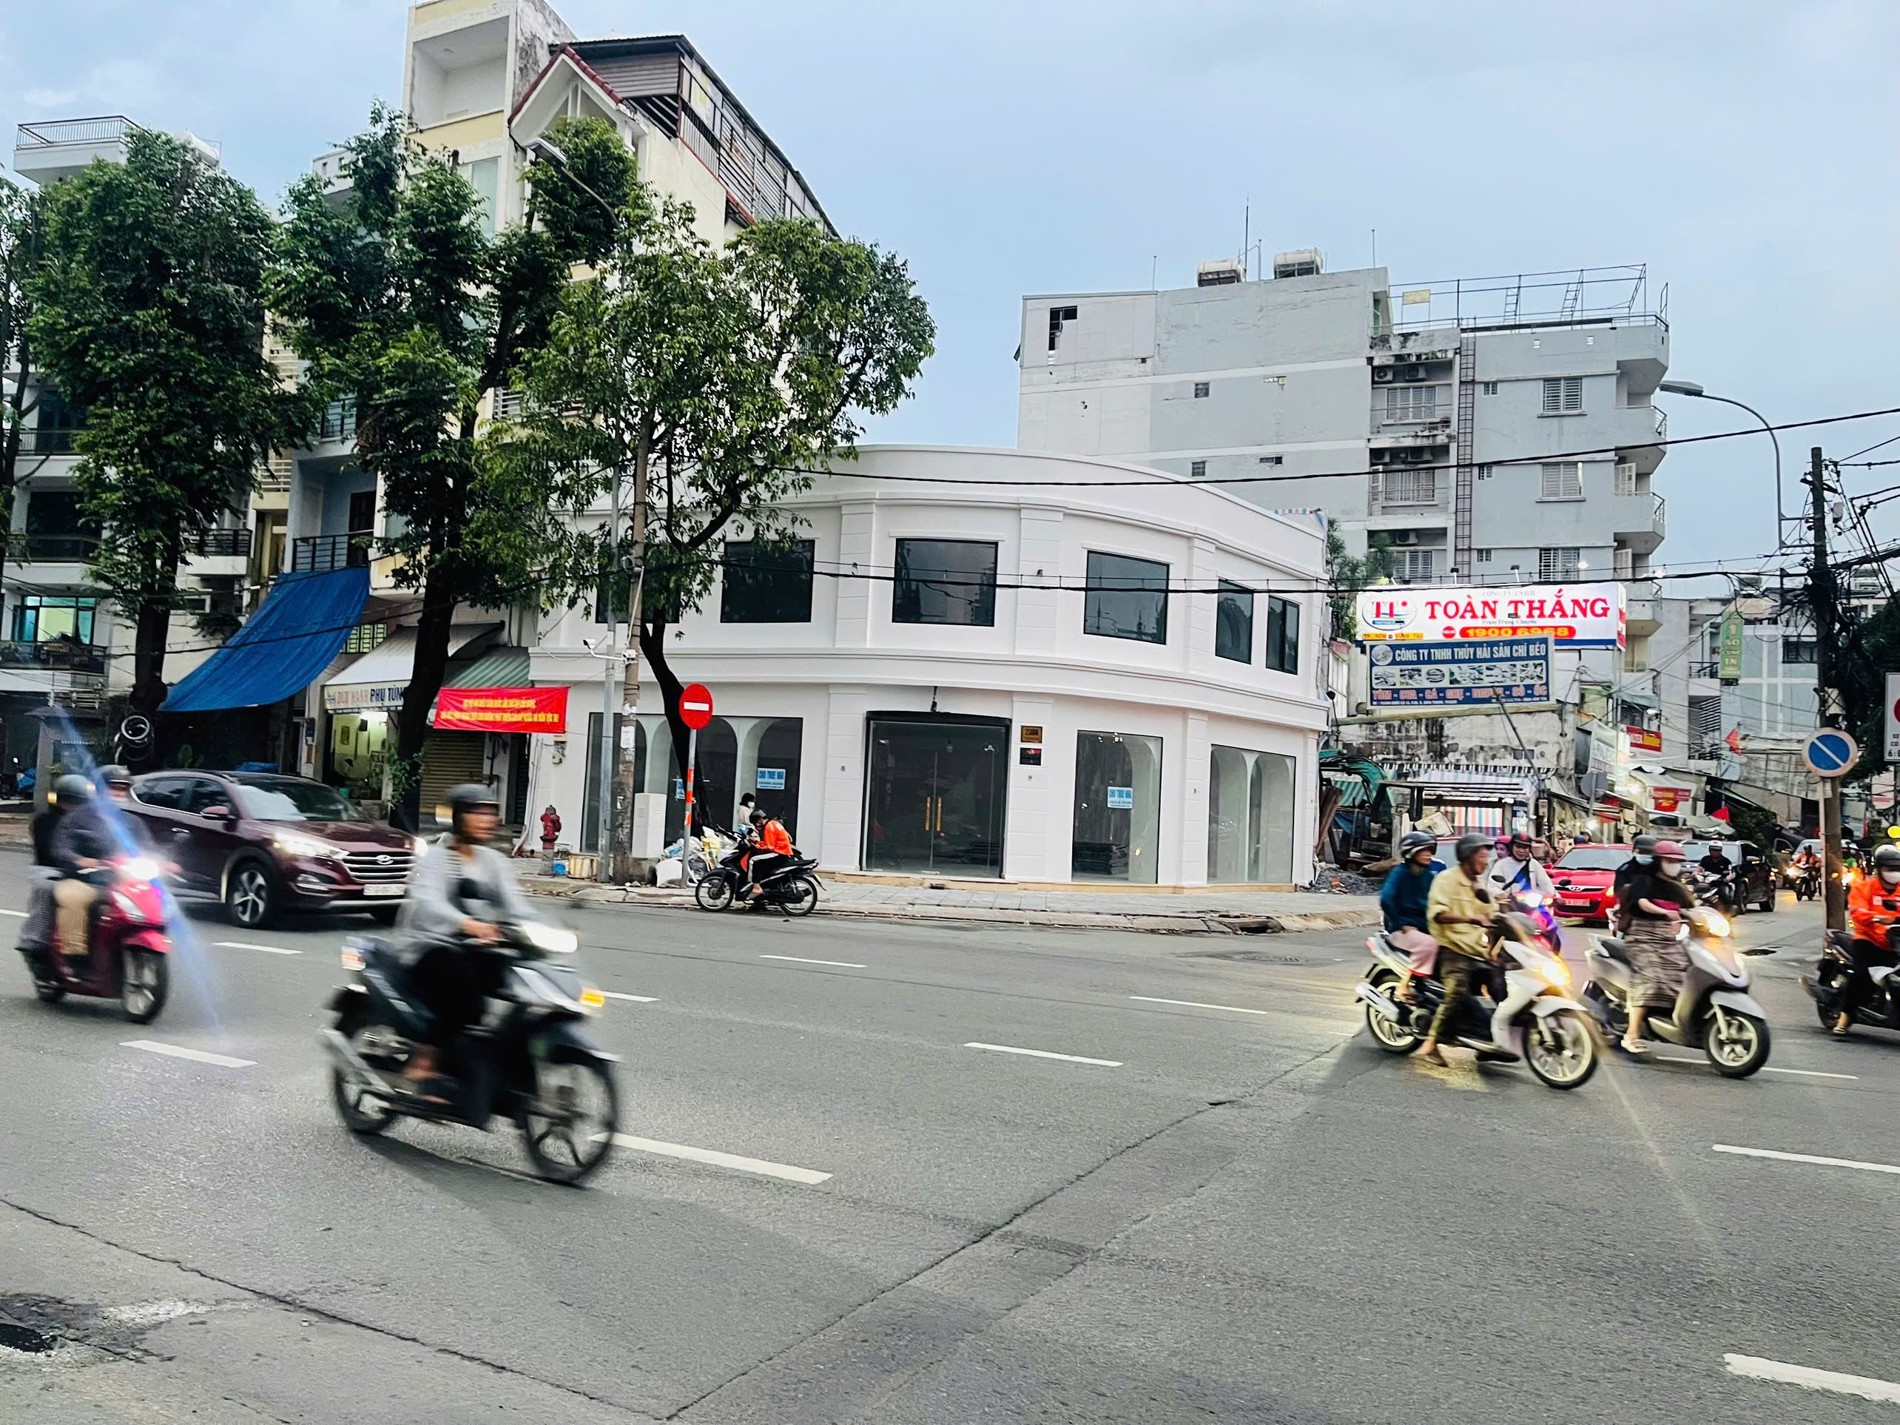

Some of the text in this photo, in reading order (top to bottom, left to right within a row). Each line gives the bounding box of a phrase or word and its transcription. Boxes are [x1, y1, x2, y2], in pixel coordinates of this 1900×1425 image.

[1425, 588, 1610, 619] TOÀN THẮNG
[1466, 627, 1512, 638] 1900
[1395, 648, 1417, 662] CÔNG
[1419, 649, 1429, 661] TY
[1430, 648, 1452, 661] TNHH
[1453, 644, 1475, 660] THỦY
[1476, 643, 1491, 659] HẢI
[1492, 642, 1511, 658] SẢN
[1529, 641, 1547, 656] BÉO
